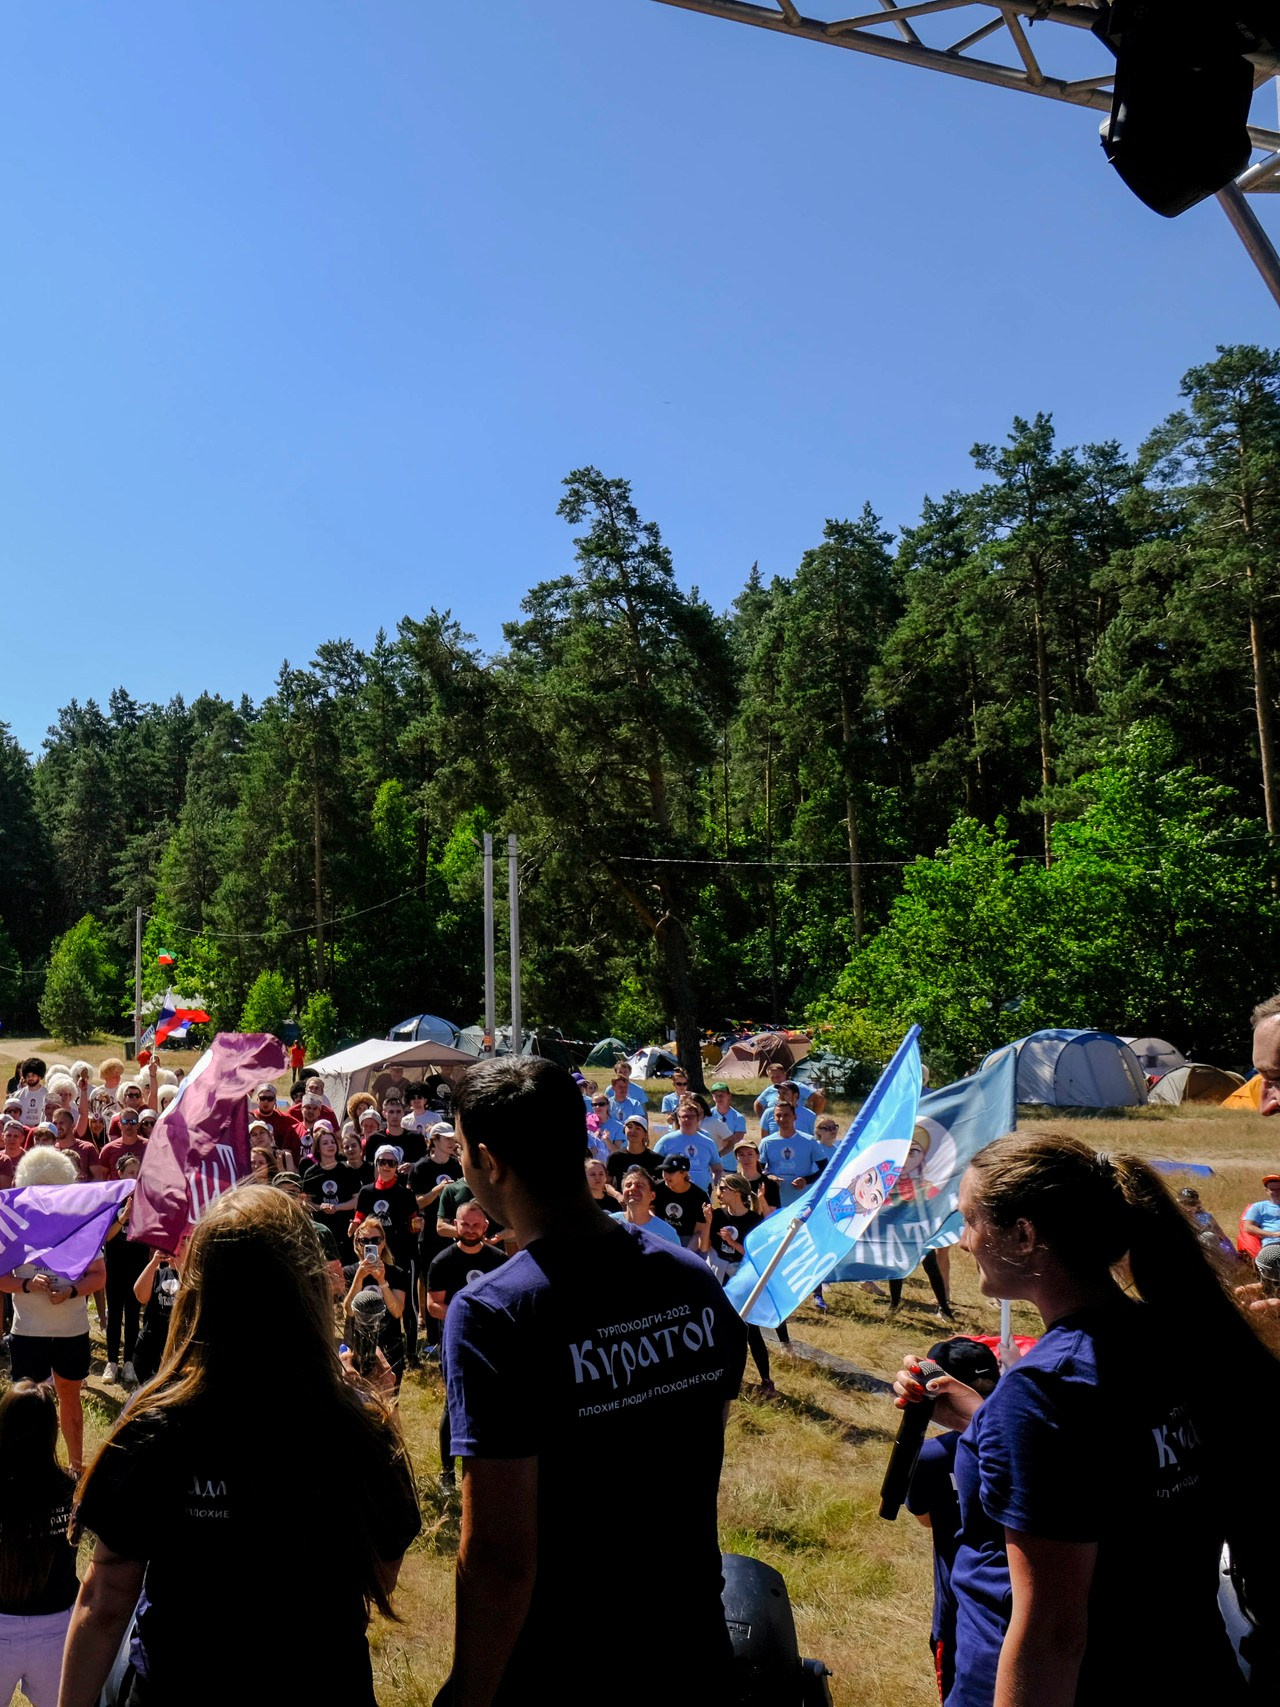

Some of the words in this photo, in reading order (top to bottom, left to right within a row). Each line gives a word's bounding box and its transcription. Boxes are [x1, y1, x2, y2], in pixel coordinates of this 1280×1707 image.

[596, 1304, 692, 1339] ТУРПОХОДГИ-2022
[569, 1306, 715, 1390] Куратор
[578, 1399, 620, 1418] ПЛОХИЕ
[621, 1391, 648, 1408] ЛЮДИ
[654, 1378, 688, 1396] ПОХОД
[688, 1374, 700, 1386] НЕ
